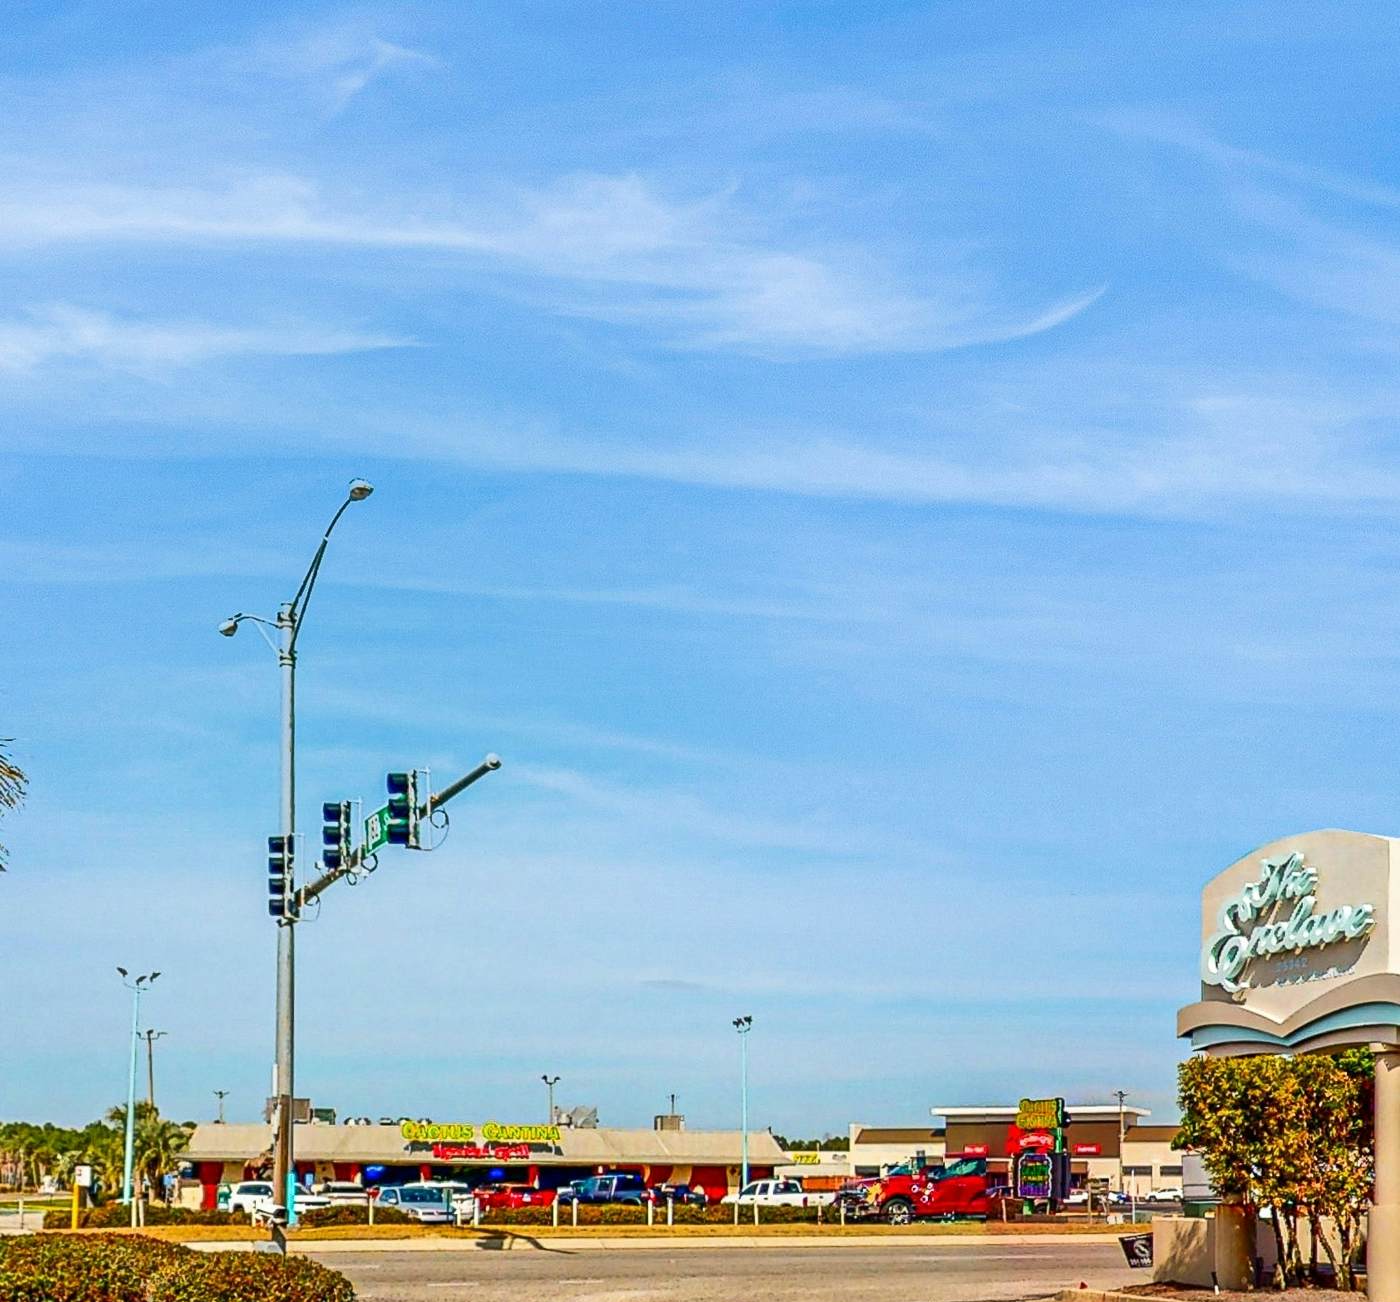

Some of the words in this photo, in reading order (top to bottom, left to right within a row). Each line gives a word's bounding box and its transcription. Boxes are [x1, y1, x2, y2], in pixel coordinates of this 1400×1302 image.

[1244, 852, 1318, 912] The
[1203, 896, 1374, 992] Enclave
[402, 1121, 474, 1140] CACTUS
[482, 1121, 560, 1141] CANTINA
